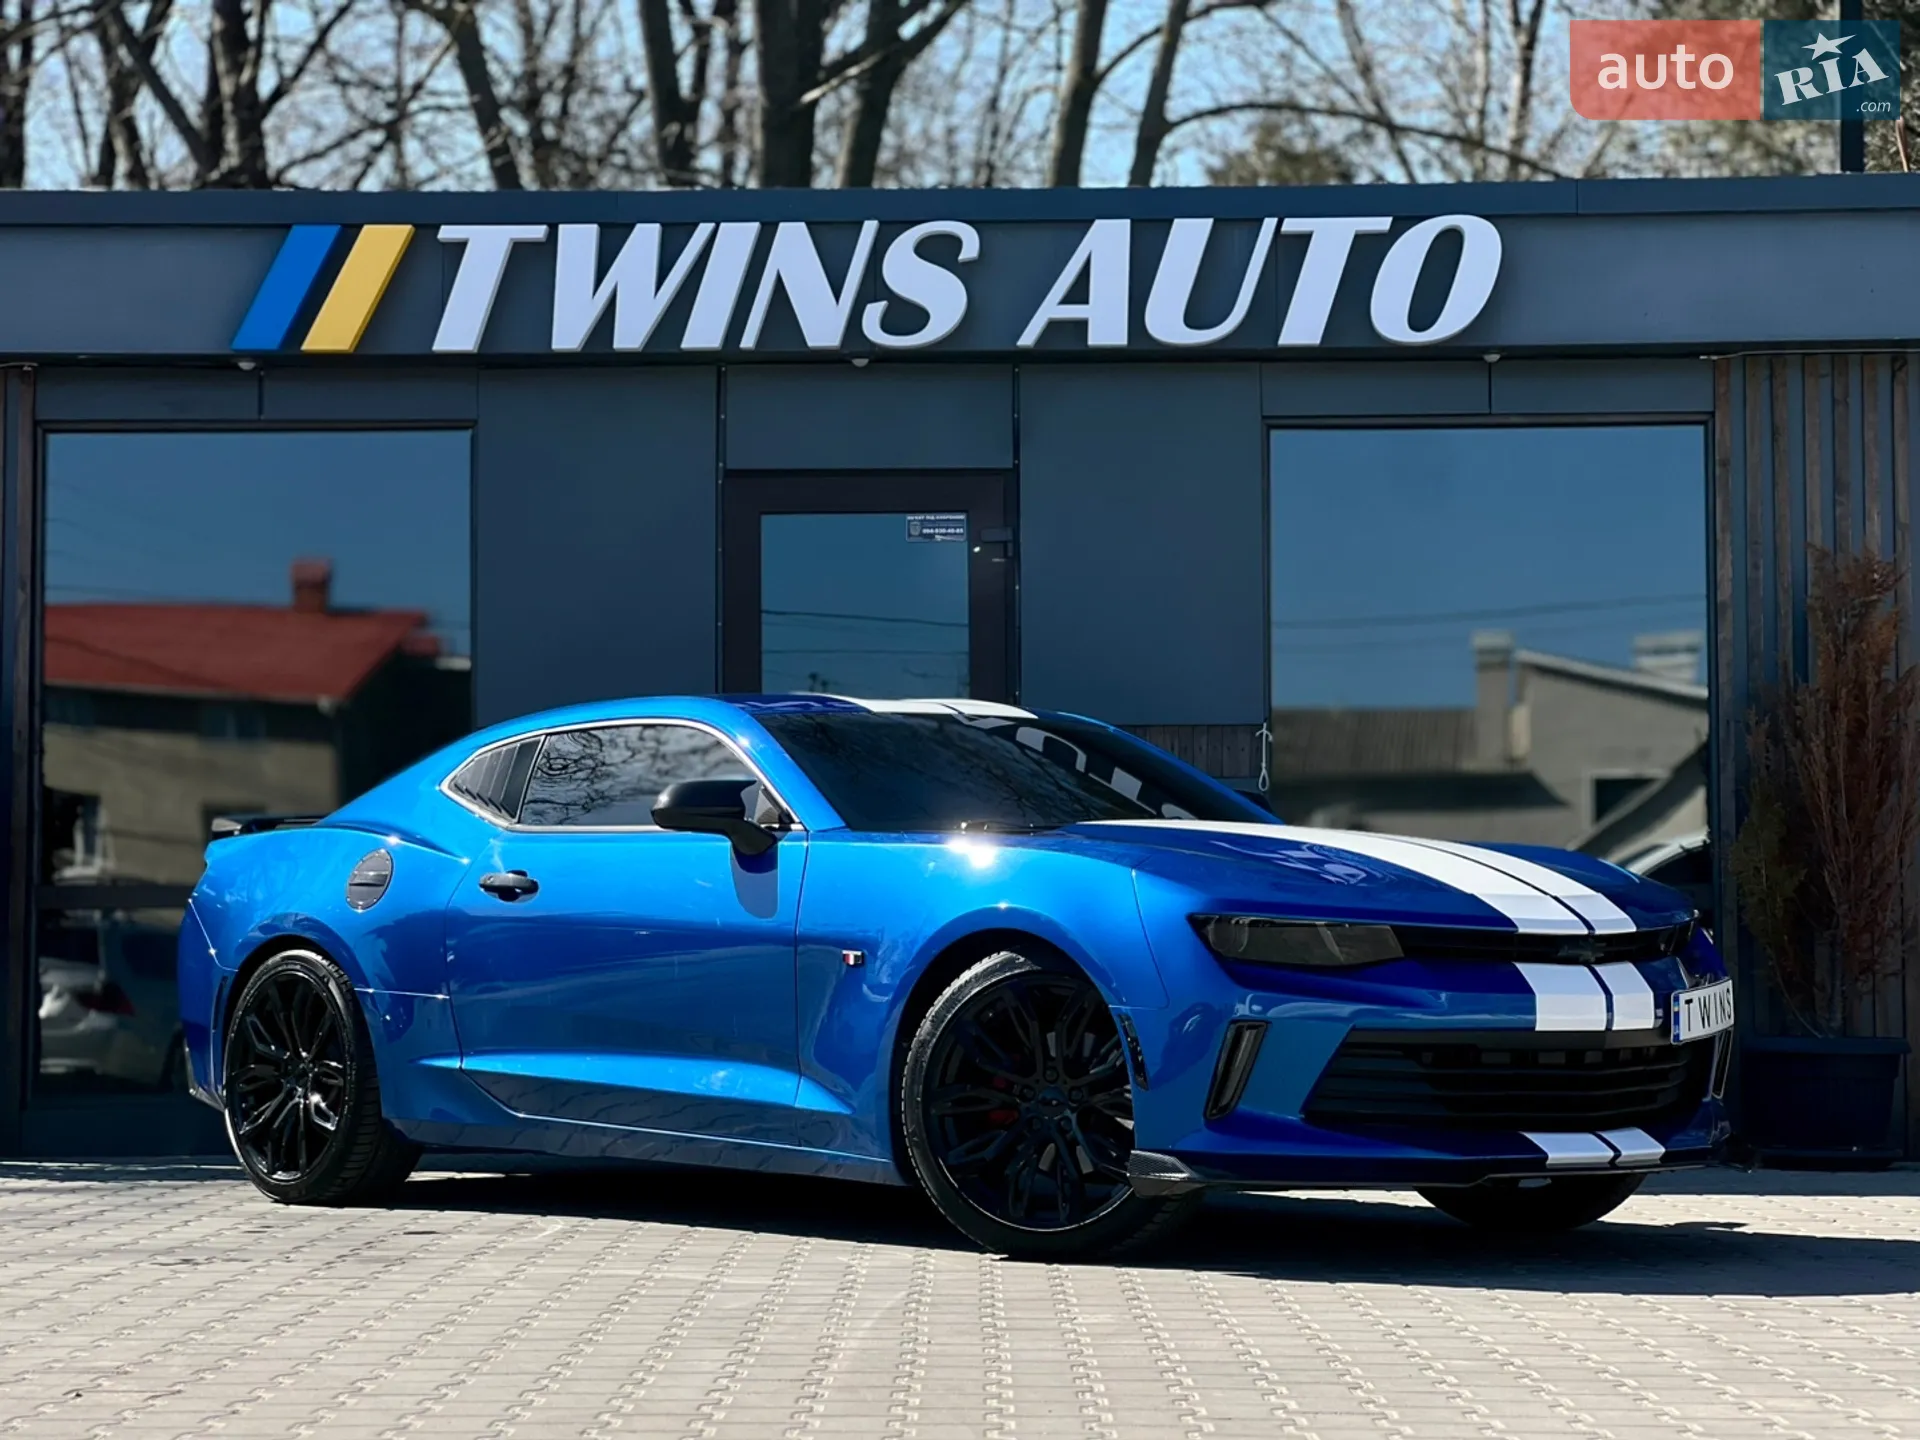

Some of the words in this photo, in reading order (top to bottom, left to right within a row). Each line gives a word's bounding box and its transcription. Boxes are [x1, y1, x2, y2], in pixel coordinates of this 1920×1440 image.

[432, 220, 980, 351] TWINS
[1017, 214, 1503, 346] AUTO
[1684, 987, 1732, 1032] TWINS
